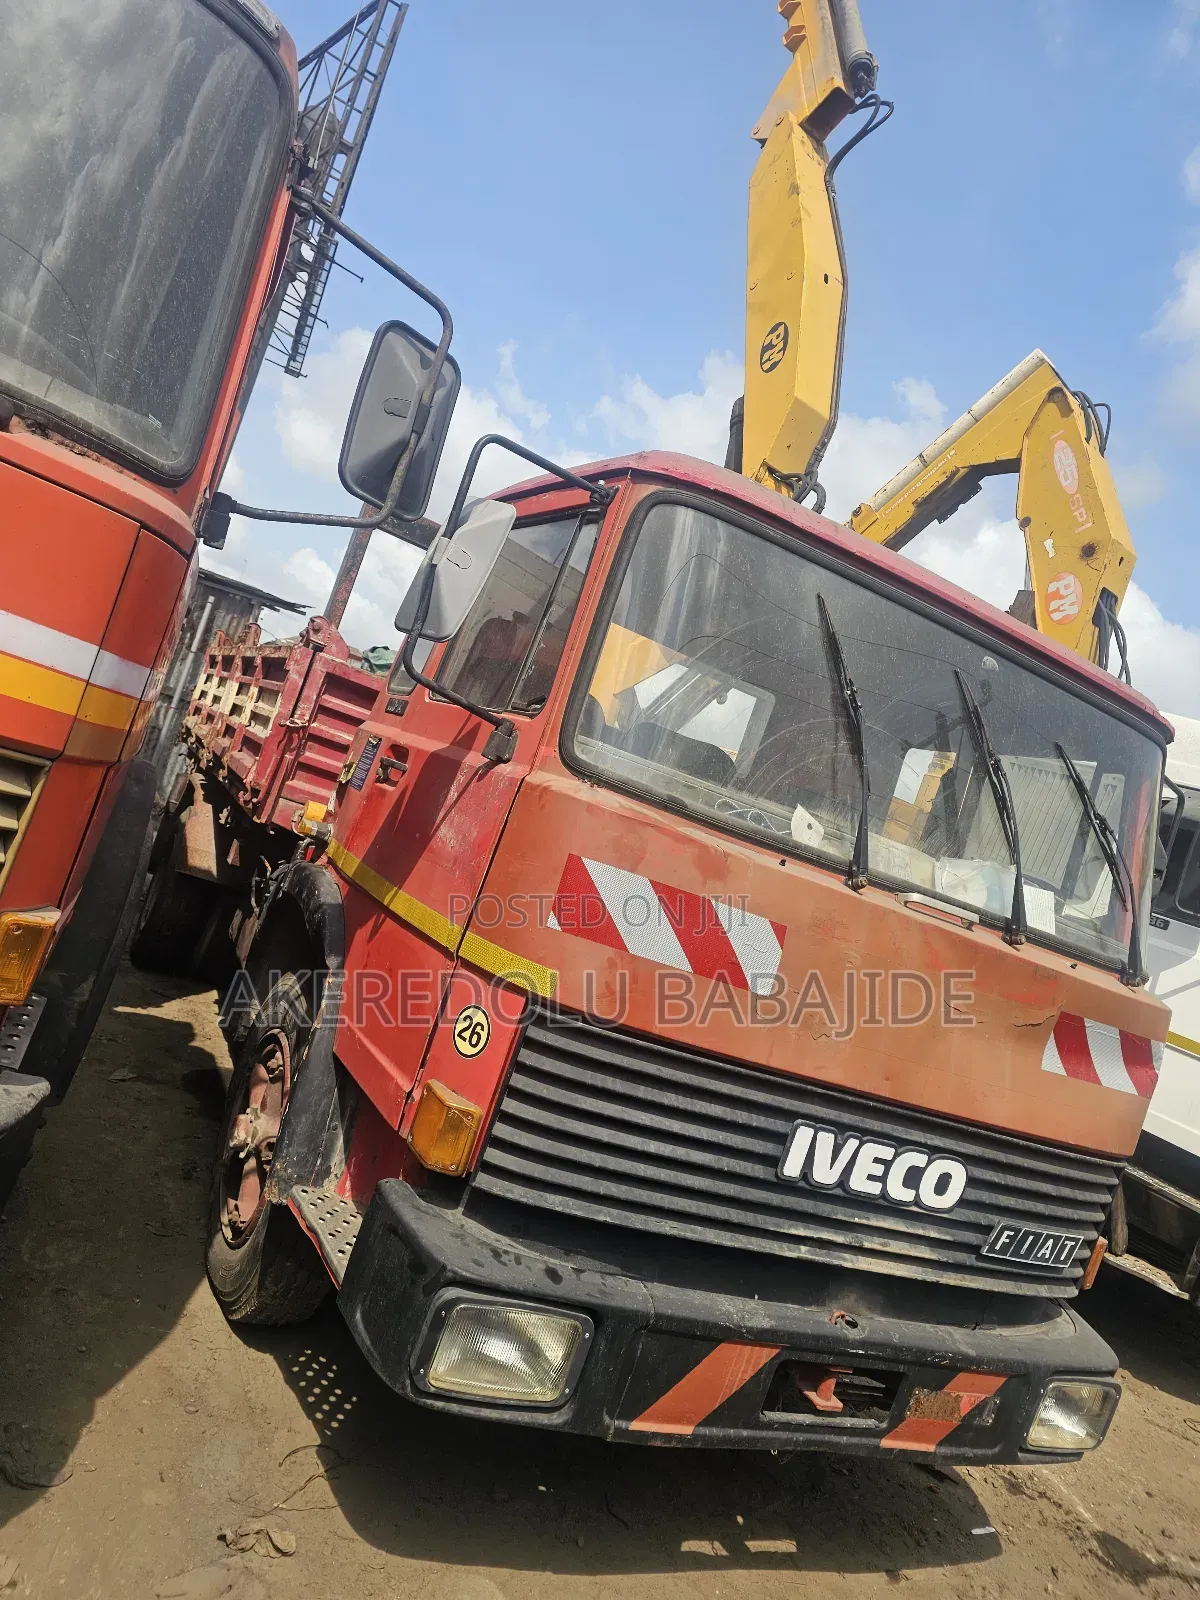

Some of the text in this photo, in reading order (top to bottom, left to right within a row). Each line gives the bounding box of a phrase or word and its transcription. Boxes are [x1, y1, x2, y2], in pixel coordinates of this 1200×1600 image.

[761, 324, 785, 371] PM
[1054, 446, 1078, 487] 25
[1047, 574, 1079, 621] PM
[457, 1014, 485, 1048] 26
[782, 1125, 967, 1210] IVECO
[994, 1230, 1076, 1261] FIAT
